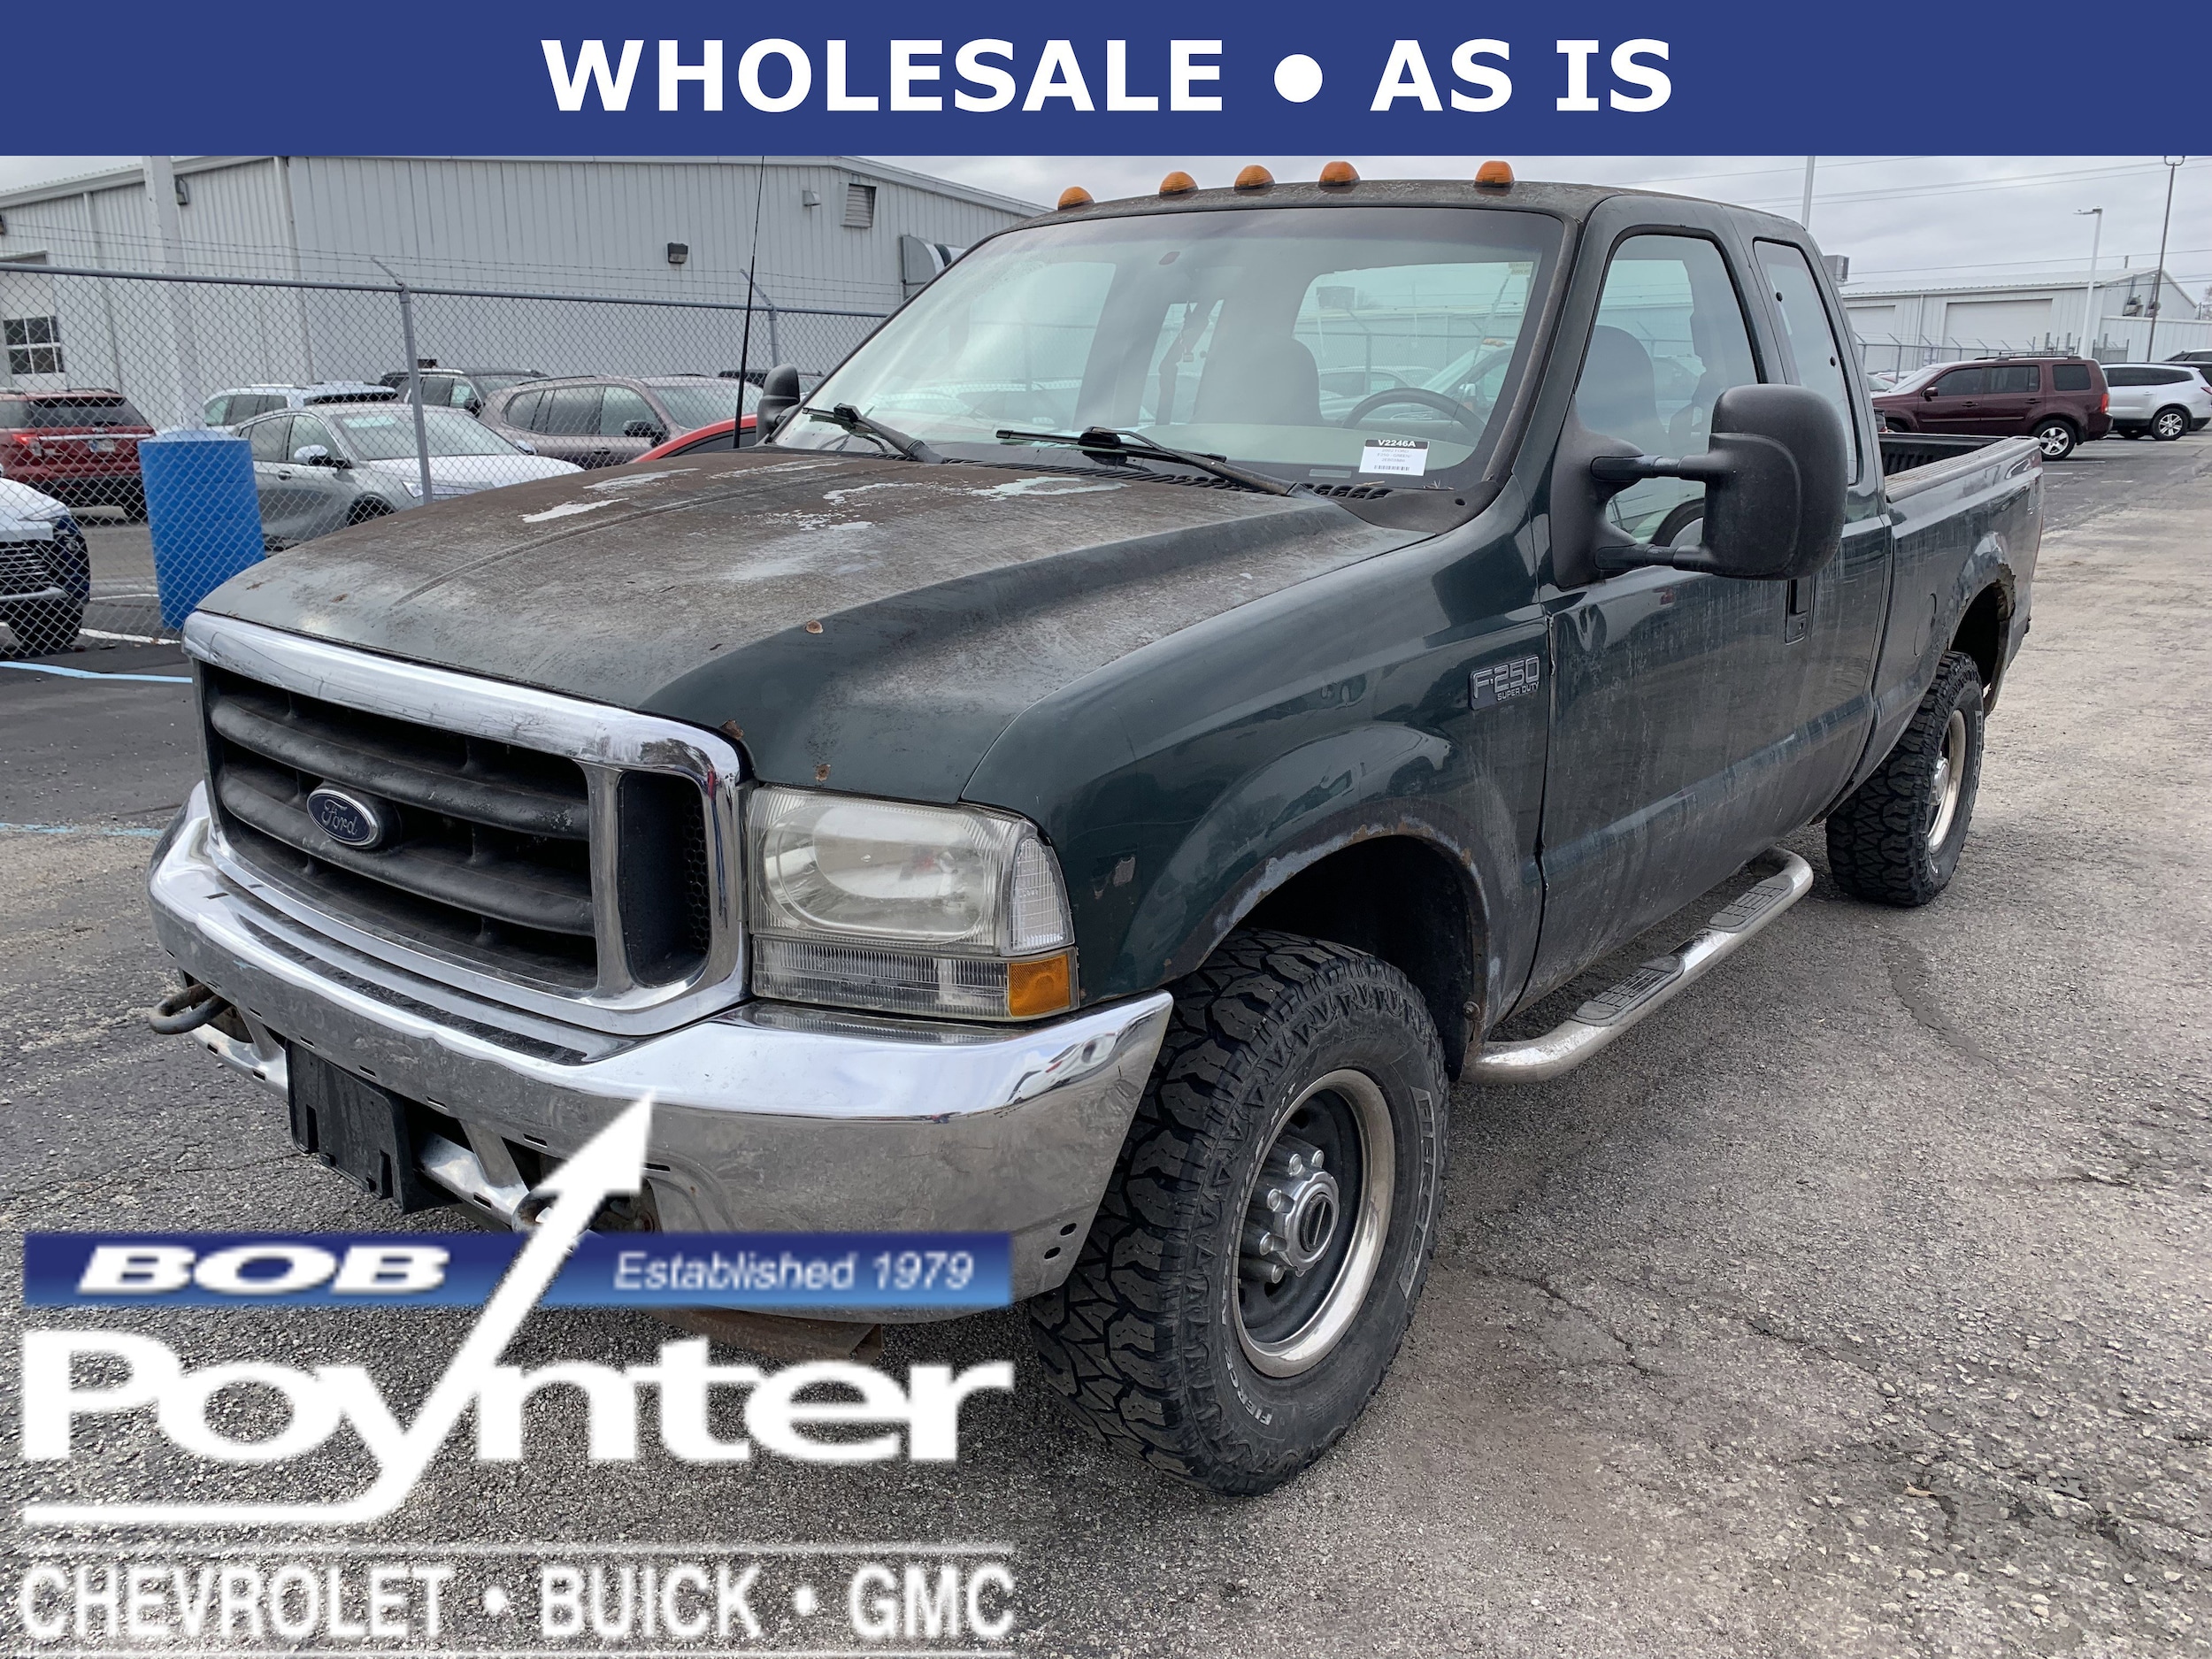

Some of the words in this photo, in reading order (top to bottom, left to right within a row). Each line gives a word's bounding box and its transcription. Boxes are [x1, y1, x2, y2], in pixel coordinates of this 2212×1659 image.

[1378, 439, 1417, 448] V2246A
[1497, 687, 1521, 701] SUPER
[1521, 681, 1540, 694] DUTY
[321, 799, 358, 835] Ford
[1225, 1350, 1273, 1425] FIERCE
